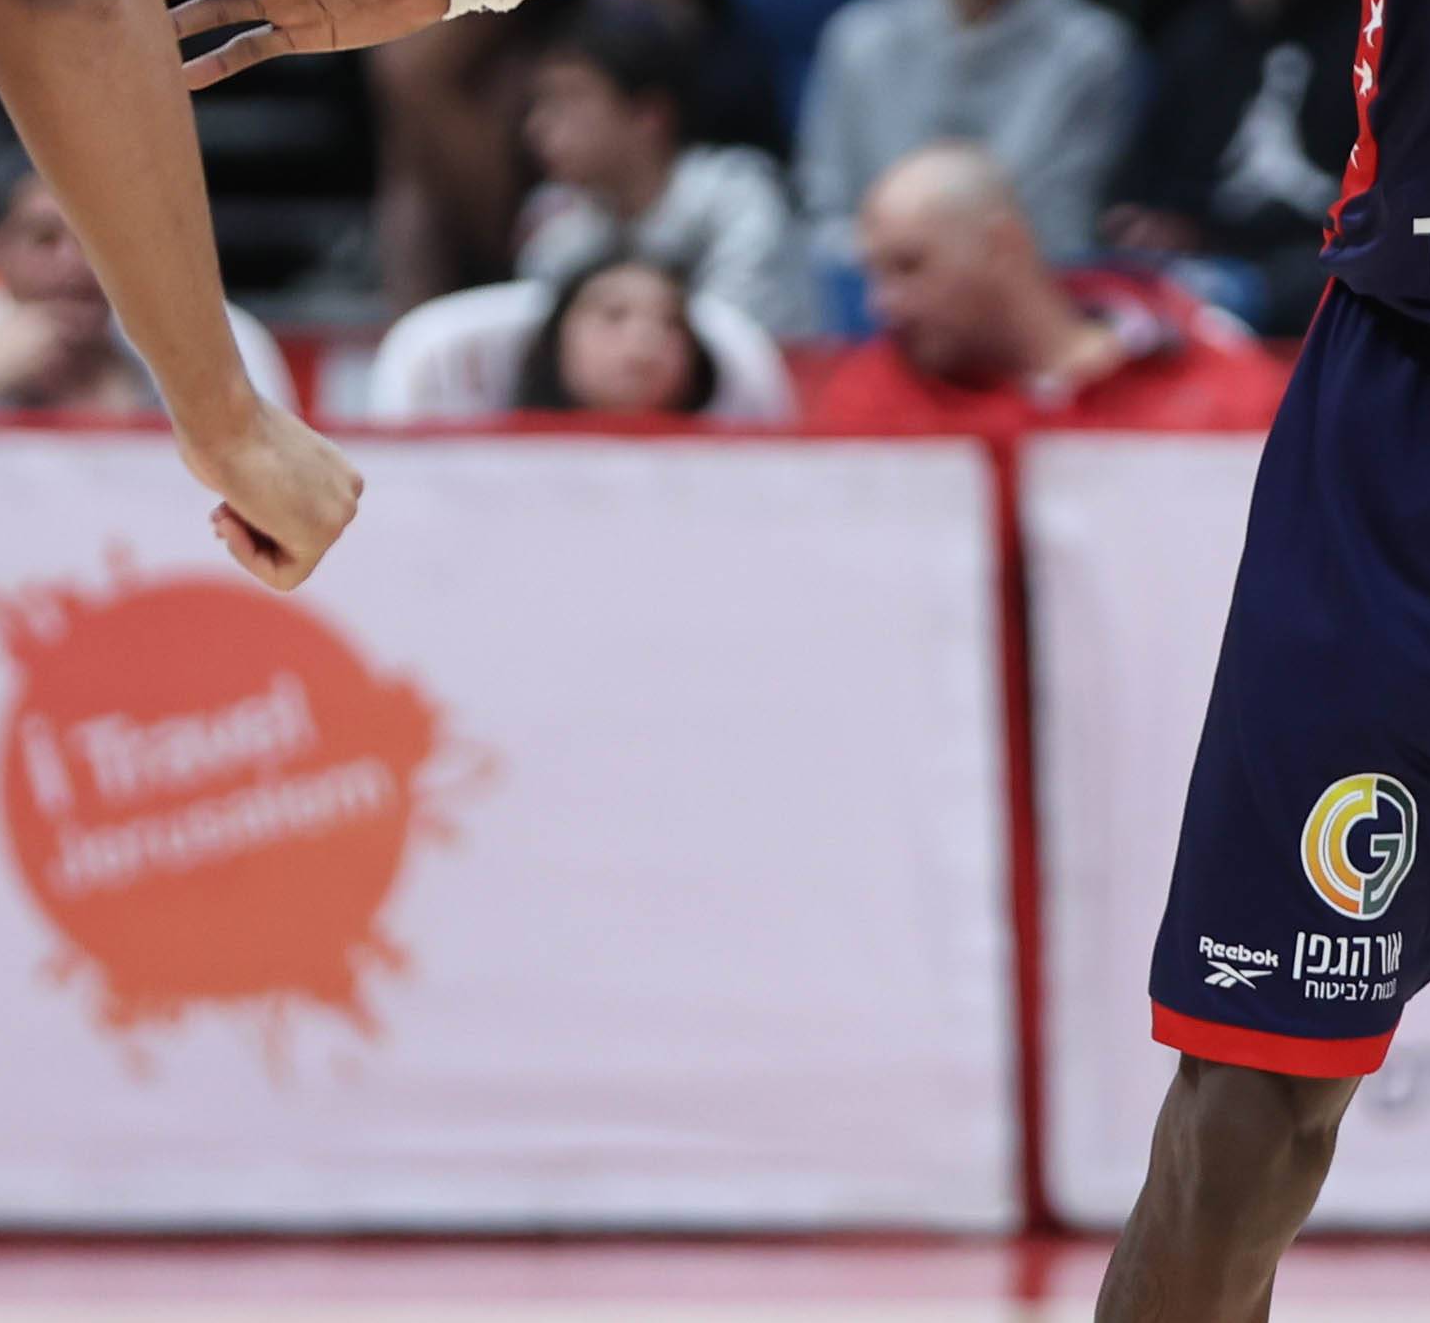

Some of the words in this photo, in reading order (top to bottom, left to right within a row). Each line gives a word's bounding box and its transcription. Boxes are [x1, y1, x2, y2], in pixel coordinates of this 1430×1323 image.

[1199, 935, 1279, 967] Reebok
[1293, 931, 1371, 980] הגפן
[1305, 979, 1369, 1001] לביטוח
